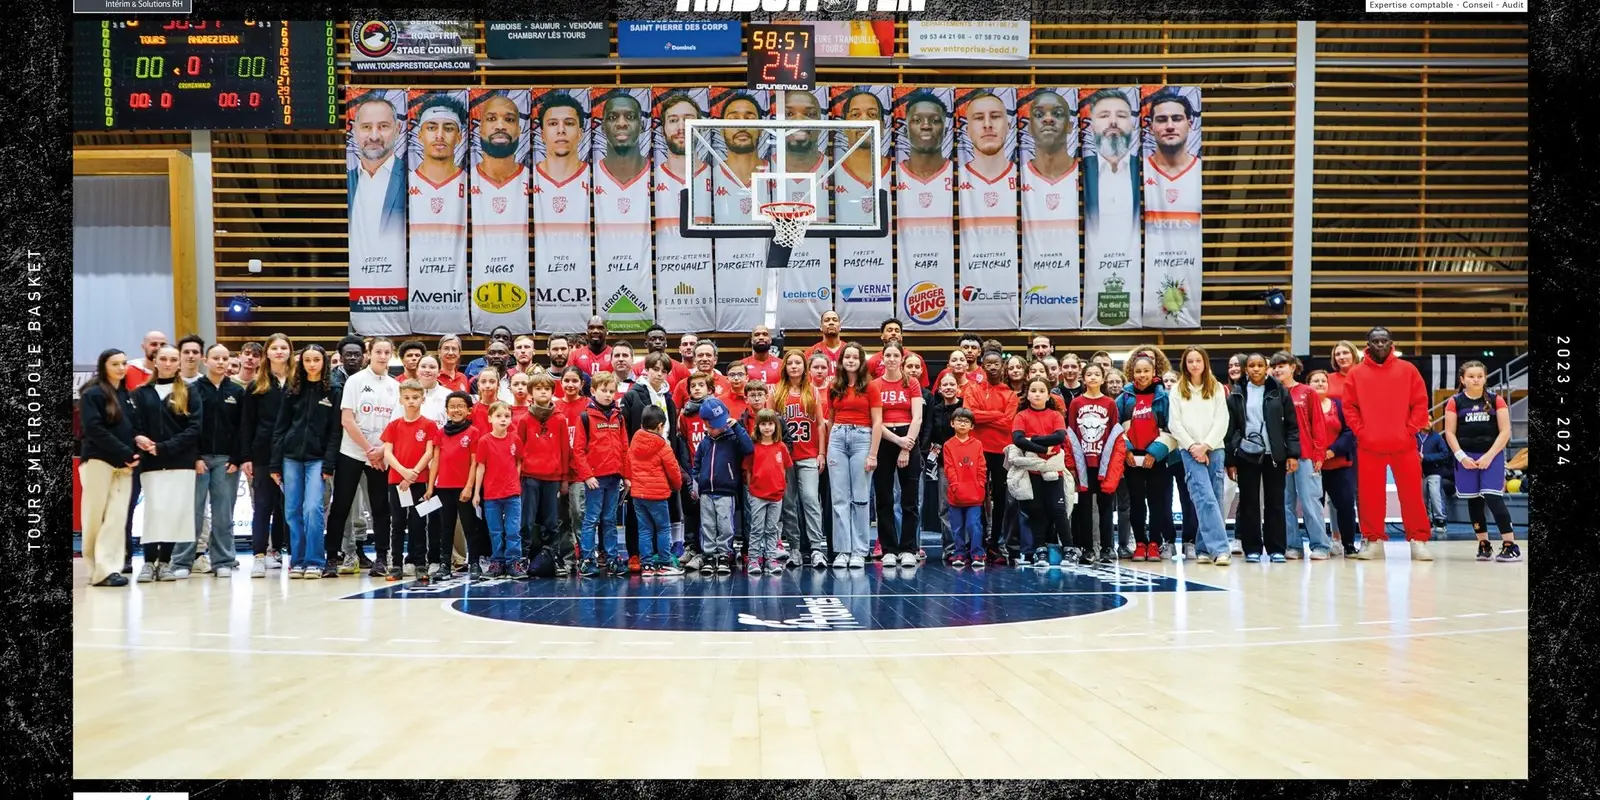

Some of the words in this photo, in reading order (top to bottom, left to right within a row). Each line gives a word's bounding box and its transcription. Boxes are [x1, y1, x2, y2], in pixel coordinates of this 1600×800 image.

[490, 23, 522, 31] AMBOISE
[530, 22, 560, 30] SAUMUR
[568, 21, 604, 30] VENDÔME
[630, 24, 653, 32] SAINT
[702, 23, 729, 31] CORPS
[139, 35, 167, 44] TOURS
[507, 32, 546, 40] CHAMBRAY
[753, 31, 809, 50] 58:57
[814, 35, 832, 44] EURE
[821, 44, 844, 53] TOURS
[920, 45, 1018, 55] www.entreprise-bedd.fr
[135, 56, 164, 78] 00
[187, 56, 200, 75] 0
[238, 56, 265, 77] 00
[356, 61, 470, 70] WWW.TOURSPRESTIGECARS.COM
[763, 51, 800, 79] 24
[606, 262, 639, 273] SYLLA
[660, 261, 711, 273] DROUAULT
[843, 258, 885, 268] PASCHAL
[914, 260, 939, 269] KABA
[968, 259, 1012, 270] VENCKUS
[1033, 260, 1071, 270] MAYOLA
[1098, 260, 1133, 270] DOUET
[1153, 258, 1196, 268] MINCEAU
[361, 264, 392, 274] HEITZ
[419, 264, 456, 274] VITALE
[484, 264, 514, 274] SUGGS
[783, 290, 817, 299] Leclerc
[858, 284, 891, 294] VERNAT
[357, 295, 399, 306] ARTUS
[411, 289, 463, 304] Avenir
[537, 287, 591, 303] M.C.P.
[620, 284, 648, 312] MERLIN
[908, 288, 944, 305] BURGER
[1029, 293, 1078, 305] Atlantes
[601, 289, 622, 313] LEROY
[910, 297, 946, 317] KING
[760, 371, 766, 382] 3
[881, 391, 907, 402] USA
[1078, 404, 1108, 417] CHICAGO
[787, 421, 811, 442] 23
